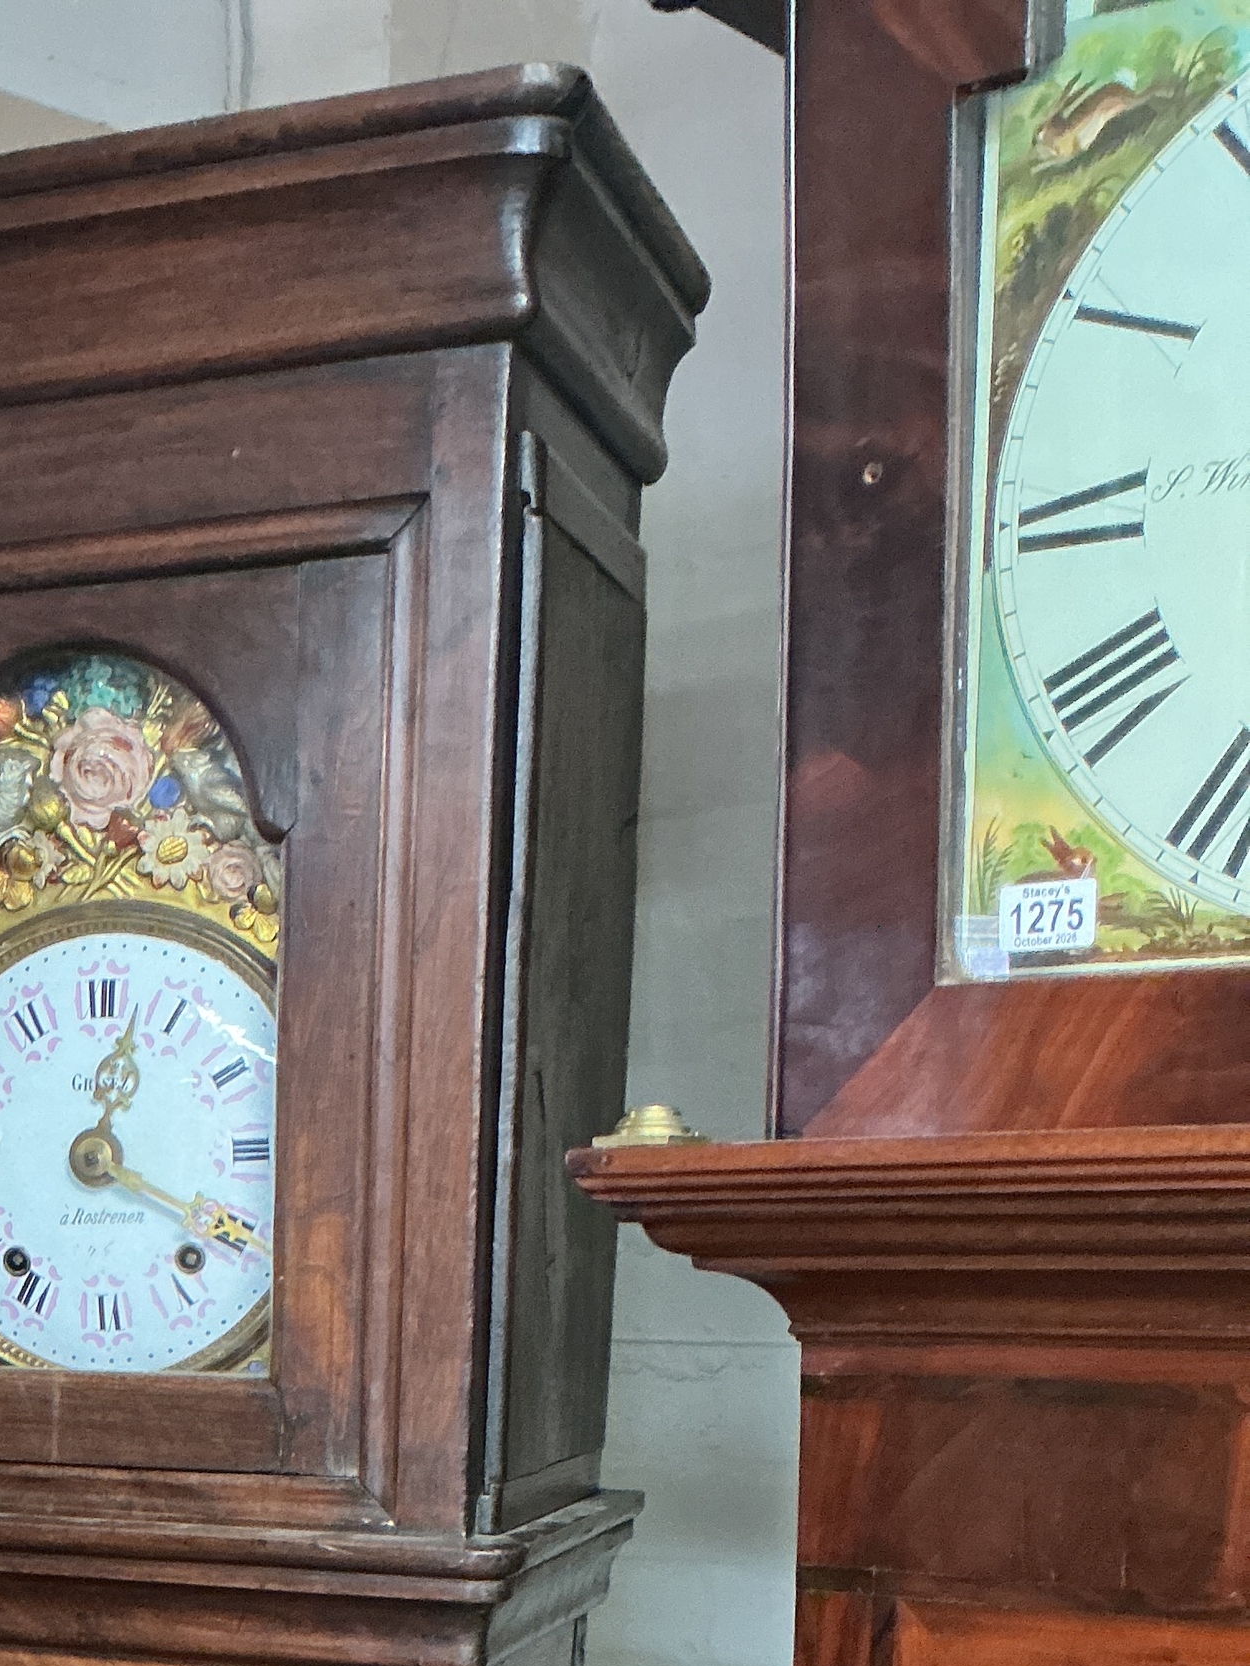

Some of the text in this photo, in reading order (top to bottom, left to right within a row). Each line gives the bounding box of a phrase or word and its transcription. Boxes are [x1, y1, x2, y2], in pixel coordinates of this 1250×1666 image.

[1068, 266, 1207, 379] X
[1017, 456, 1152, 563] IX
[1037, 596, 1191, 777] VIII
[1022, 883, 1070, 899] Stacey's
[1010, 897, 1084, 936] 1275
[1013, 935, 1053, 949] October
[81, 978, 121, 1020] XII
[160, 996, 191, 1037] I
[10, 999, 50, 1050] XI
[208, 1055, 250, 1093] II
[232, 1134, 270, 1167] III
[12, 1269, 52, 1316] VII
[94, 1293, 127, 1333] VI
[171, 1272, 200, 1313] V
